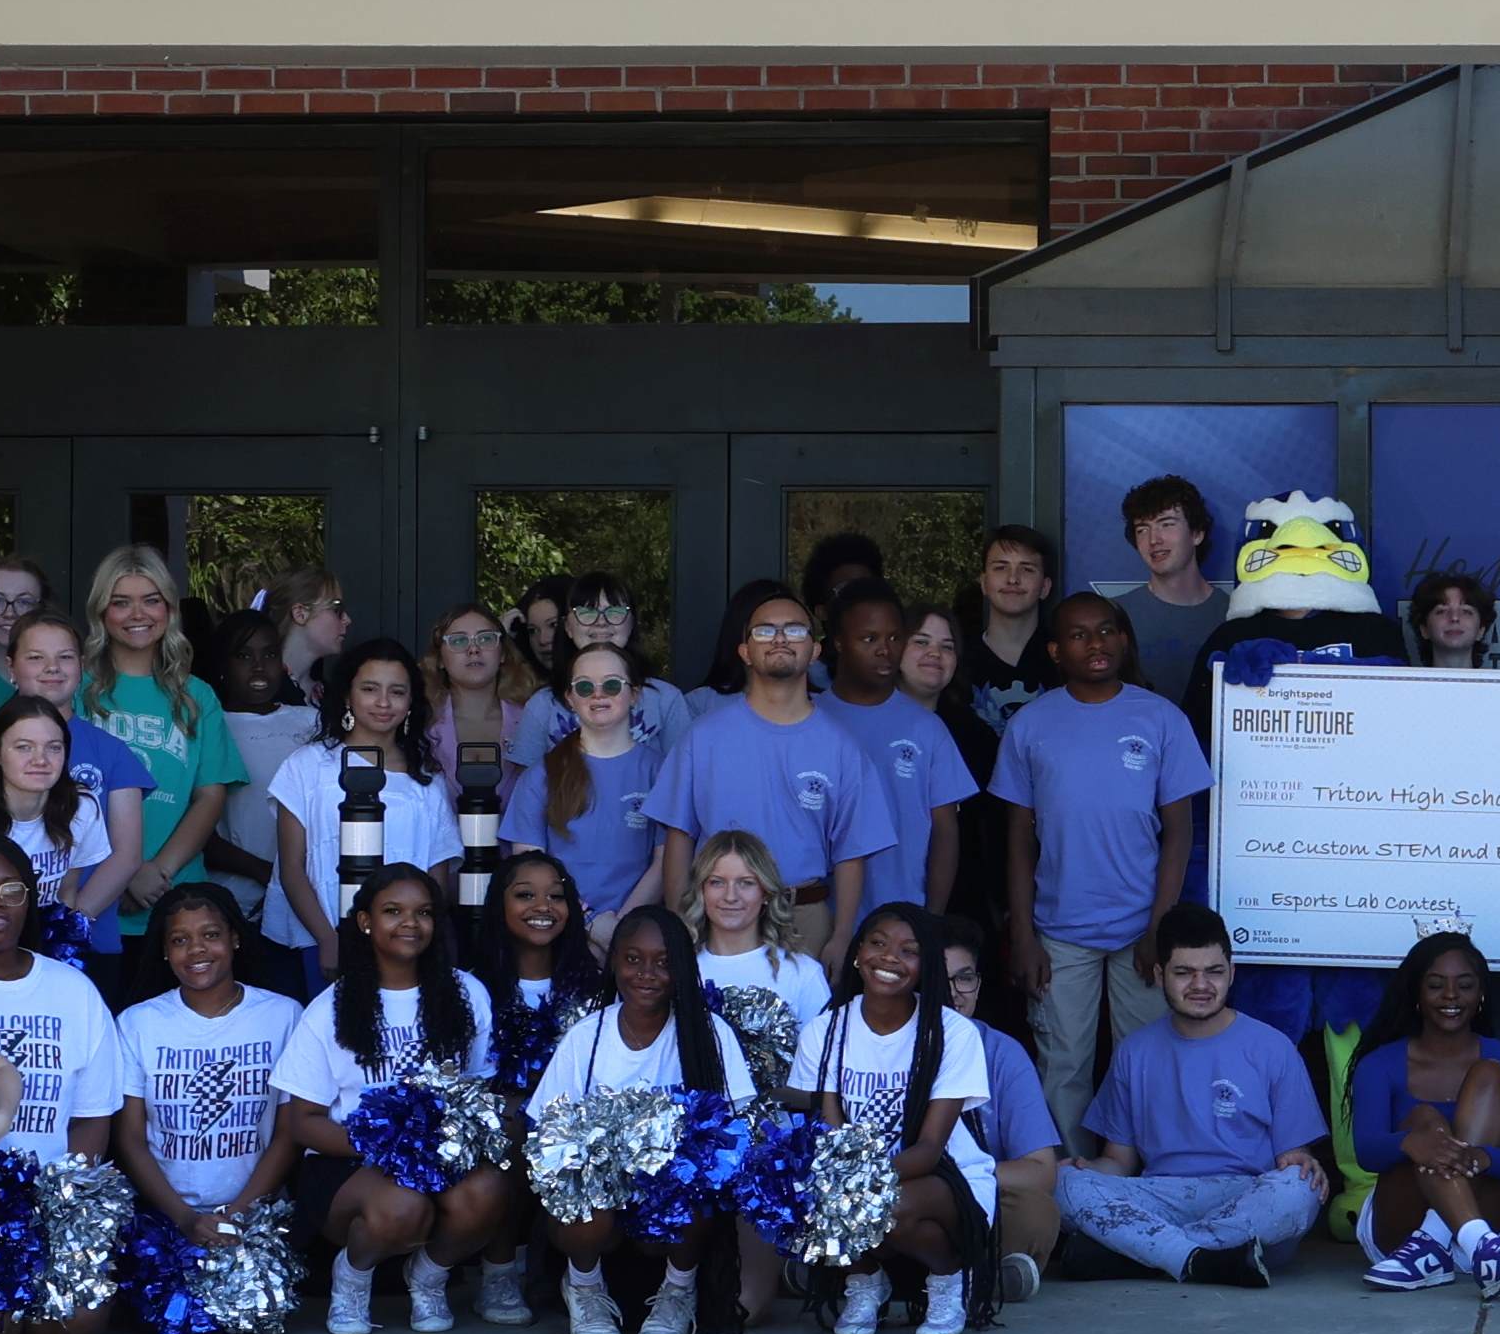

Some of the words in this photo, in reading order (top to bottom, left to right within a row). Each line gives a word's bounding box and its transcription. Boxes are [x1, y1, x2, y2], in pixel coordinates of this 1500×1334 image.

[1268, 688, 1333, 700] brightspeed
[1232, 708, 1291, 733] BRIGHT
[1295, 710, 1355, 736] FUTURE
[93, 710, 188, 768] OSA
[1240, 779, 1261, 790] PAY
[1263, 780, 1278, 790] TO
[1280, 781, 1302, 791] THE
[1240, 791, 1276, 801] ORDER
[1281, 792, 1295, 801] OF
[1312, 782, 1382, 803] Triton
[1389, 784, 1445, 810] High
[1244, 838, 1285, 855] One
[1291, 839, 1370, 856] Custom
[1375, 842, 1442, 858] STEM
[1449, 843, 1489, 860] and
[1238, 897, 1260, 907] FOR
[1271, 892, 1338, 913] Esports
[1345, 894, 1378, 910] Lab
[1385, 897, 1455, 912] Contest
[1253, 929, 1271, 937] STAY
[1253, 936, 1290, 944] PLUGGED
[10, 1014, 62, 1042] CHEER
[19, 1043, 63, 1070] HEER
[156, 1046, 216, 1071] TRITON
[220, 1041, 273, 1067] CHEER
[20, 1073, 63, 1102] HEER
[153, 1073, 191, 1100] TRIT
[225, 1068, 272, 1097] HEER
[843, 1067, 888, 1098] RITON
[154, 1104, 200, 1131] TRITO
[160, 1130, 212, 1161] TRITON
[216, 1129, 261, 1159] CHEER
